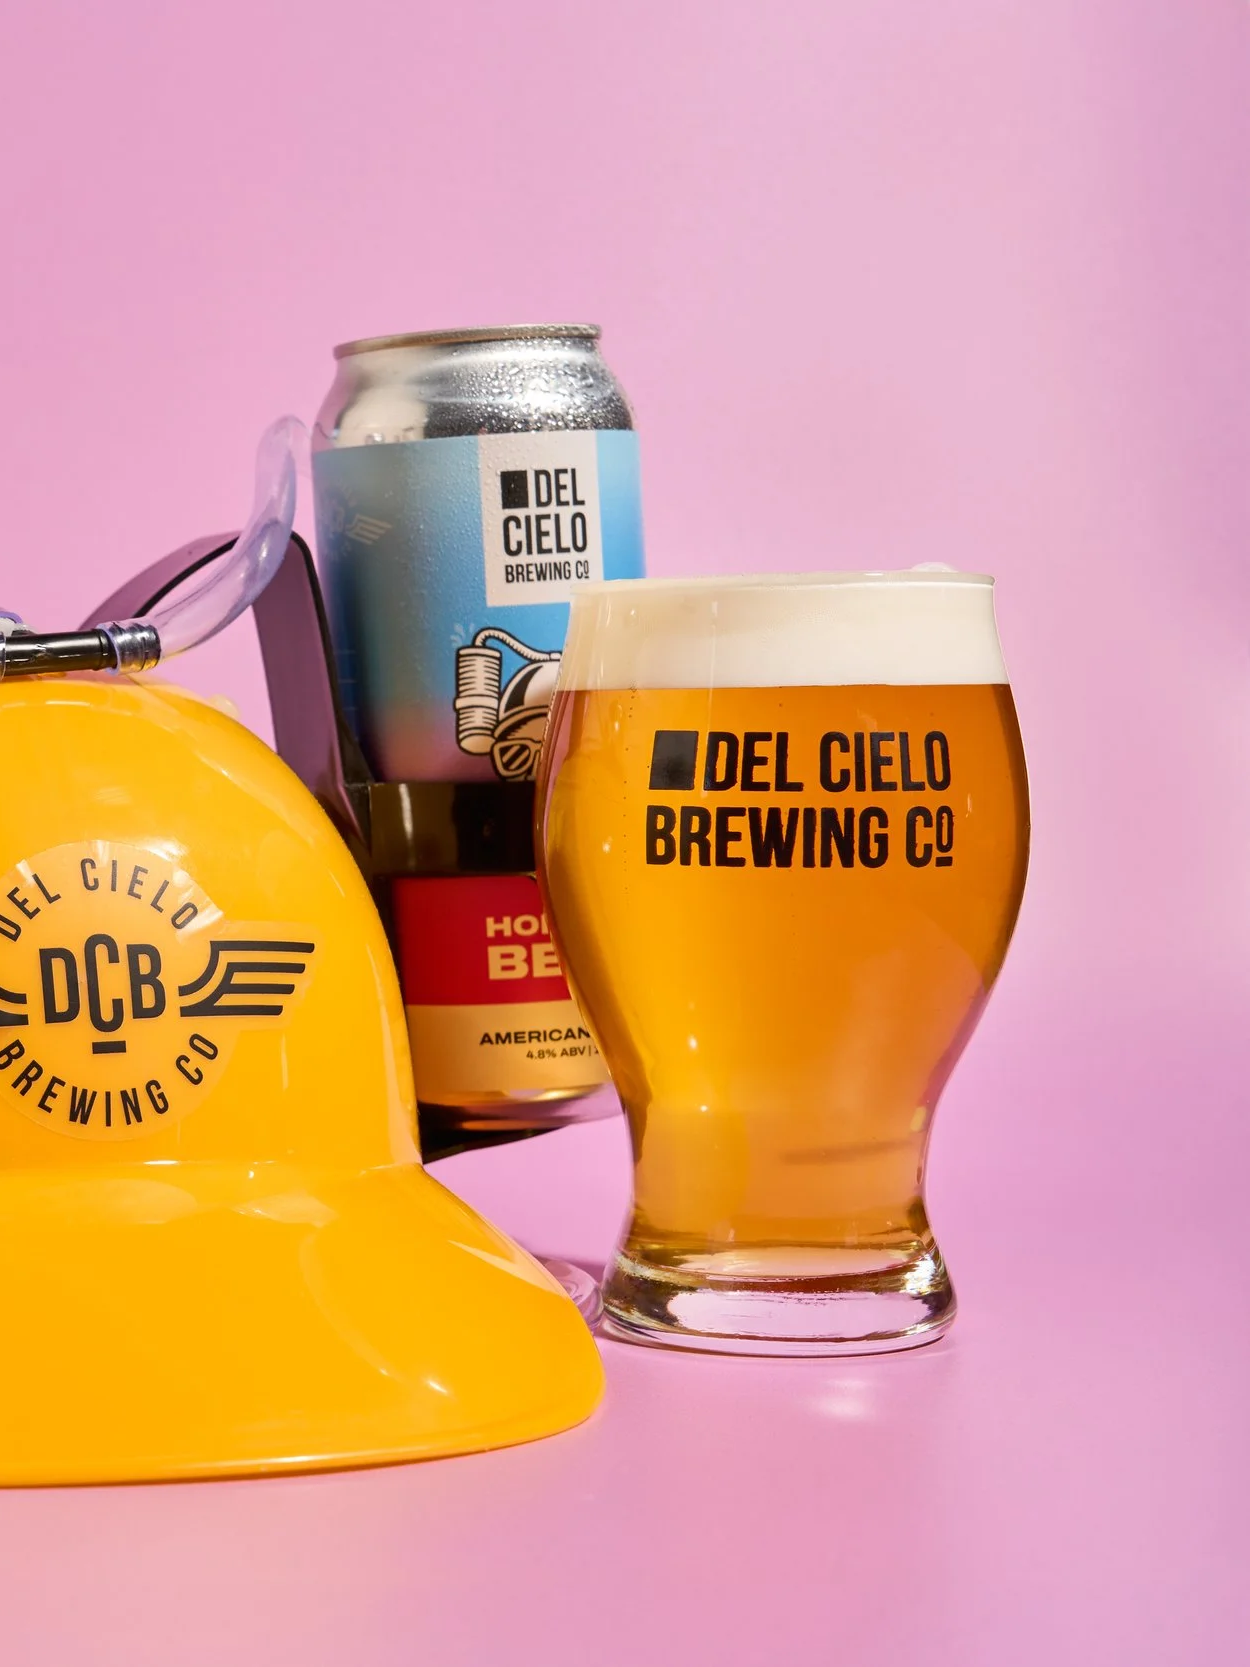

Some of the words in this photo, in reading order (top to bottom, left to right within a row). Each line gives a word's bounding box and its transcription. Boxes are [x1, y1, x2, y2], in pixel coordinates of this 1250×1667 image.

[534, 468, 585, 507] DEL
[502, 512, 587, 556] CIELO
[504, 561, 571, 583] BREWING
[703, 731, 804, 792] DEL
[819, 731, 951, 792] CIELO
[646, 805, 889, 868] BREWING
[80, 857, 199, 930] CIELO
[39, 933, 167, 1033] DCB
[487, 943, 563, 980] BE
[175, 1032, 219, 1086] CO
[526, 1049, 556, 1059] 4.8%
[560, 1046, 586, 1057] ABV
